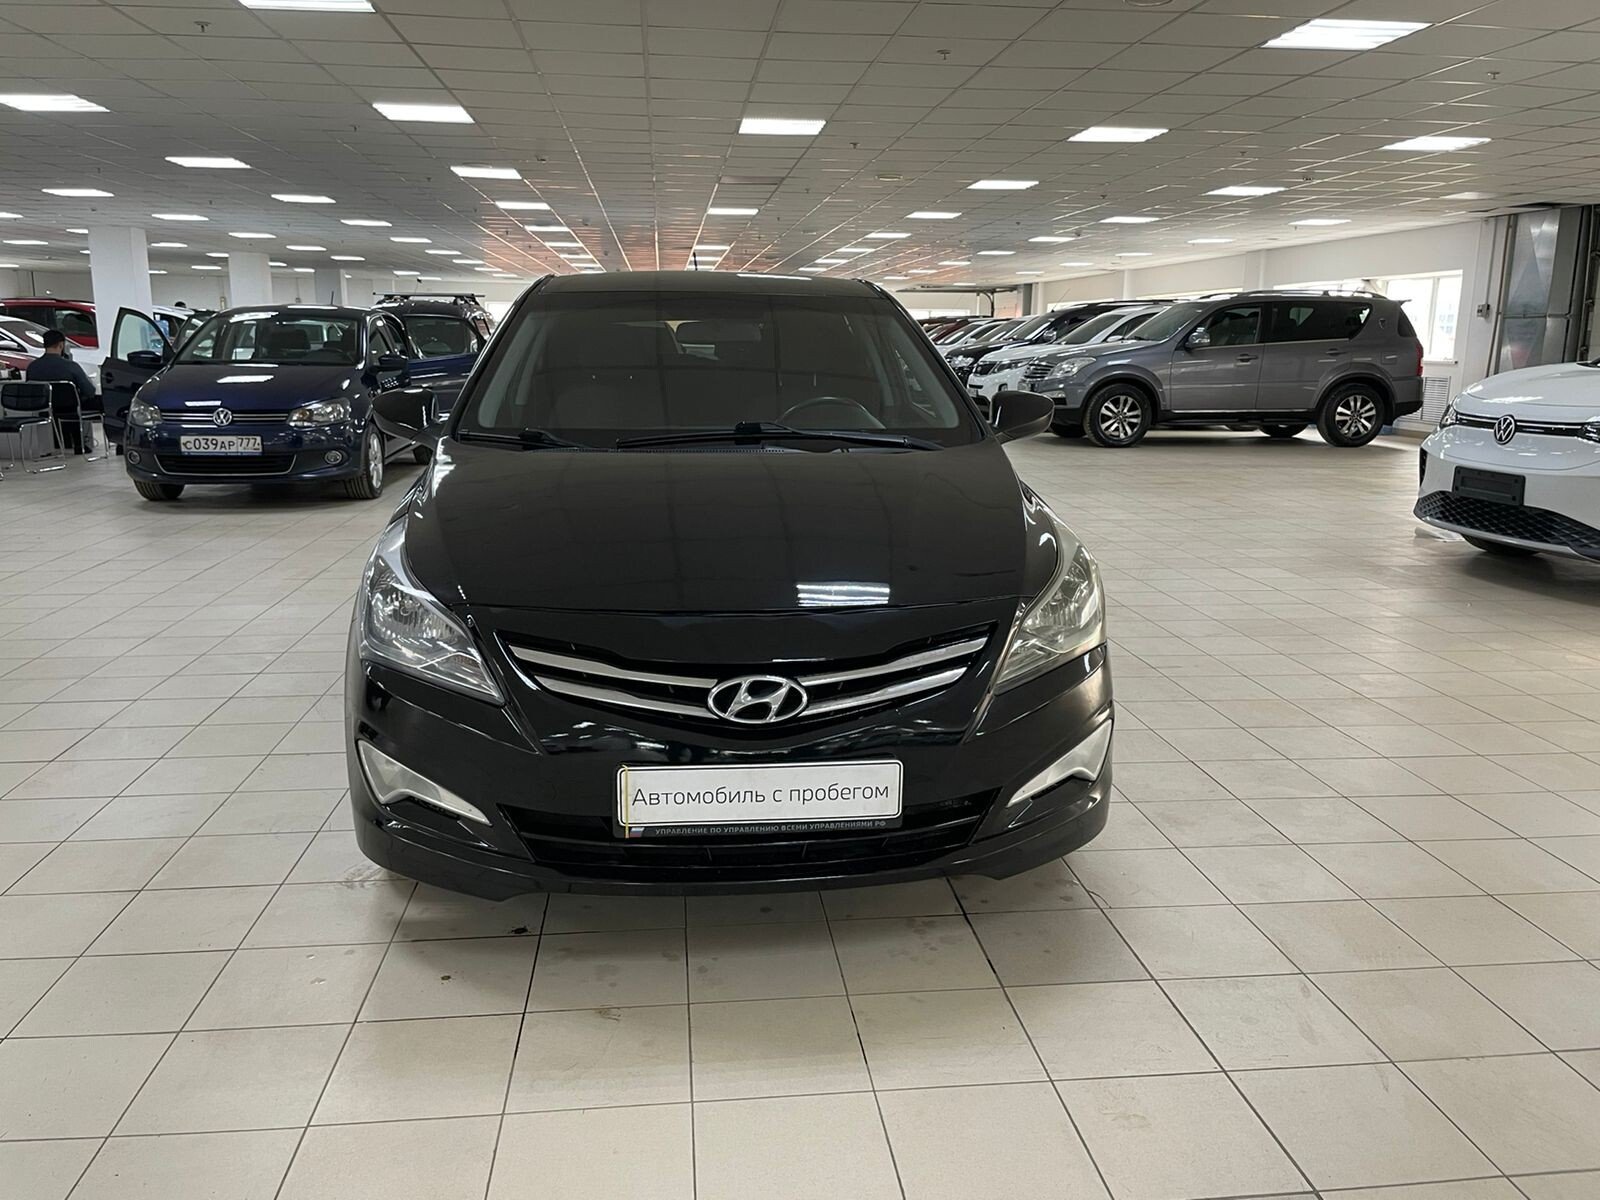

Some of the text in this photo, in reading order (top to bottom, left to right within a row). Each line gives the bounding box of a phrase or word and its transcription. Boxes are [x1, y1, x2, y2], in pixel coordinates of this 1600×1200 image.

[632, 783, 889, 806] Автомобиль с пробегом
[655, 827, 708, 835] УПРАВЛЕНИЕ
[724, 825, 780, 834] УПРАВЛЕНИЮ
[809, 821, 873, 831] УПРАВЛЕНИЯМИ
